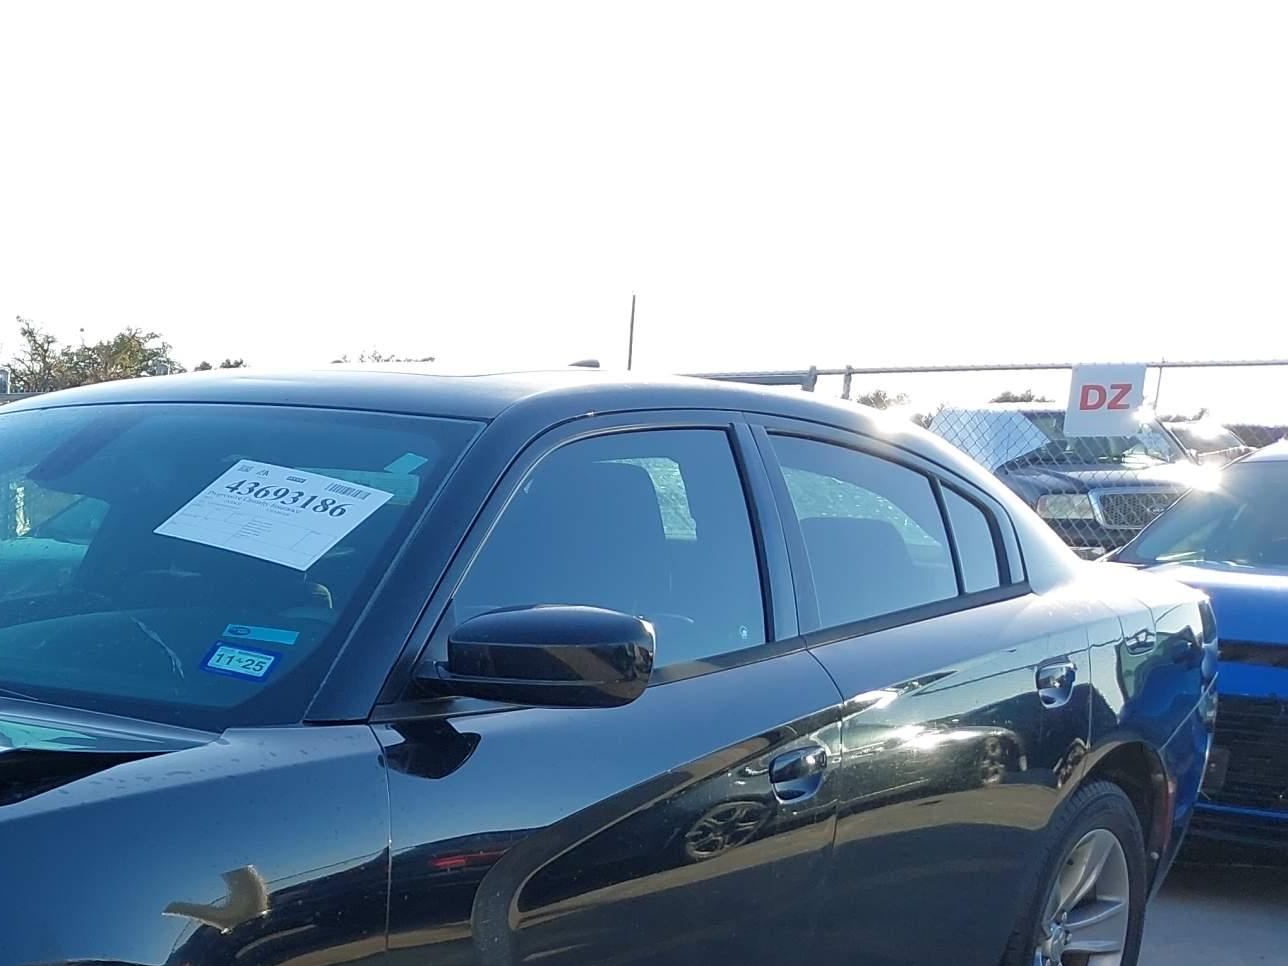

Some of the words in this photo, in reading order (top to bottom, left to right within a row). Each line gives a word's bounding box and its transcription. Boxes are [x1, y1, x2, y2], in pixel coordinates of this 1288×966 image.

[1079, 383, 1133, 411] DZ
[225, 479, 354, 518] 43693186
[215, 653, 235, 666] 11
[241, 658, 266, 672] 25
